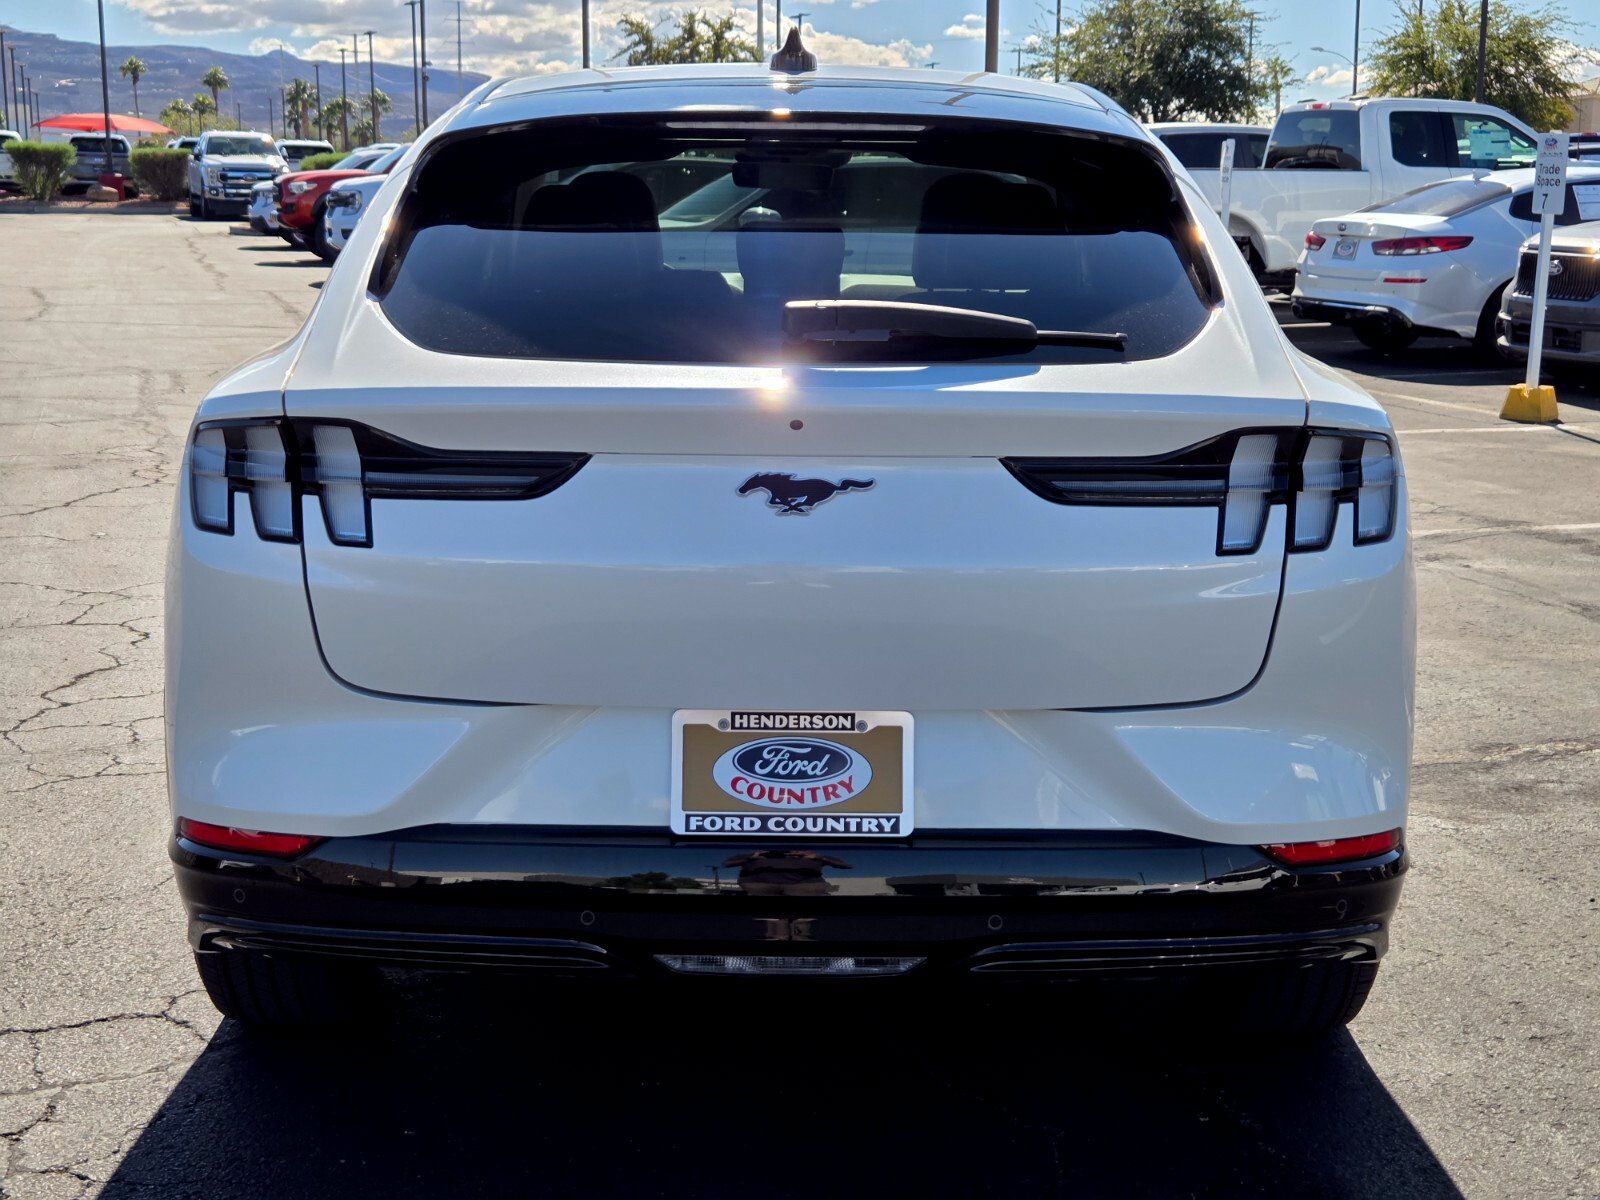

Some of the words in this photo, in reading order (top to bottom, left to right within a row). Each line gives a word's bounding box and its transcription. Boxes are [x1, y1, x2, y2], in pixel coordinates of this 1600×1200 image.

[1539, 164, 1561, 175] Trade
[1536, 176, 1561, 188] Space
[1542, 193, 1548, 209] 7
[734, 714, 852, 729] HENDERSON
[754, 745, 831, 776] Ford
[730, 775, 854, 804] COUNTRY
[689, 816, 762, 831] FORD
[767, 817, 897, 832] COUNTRY
